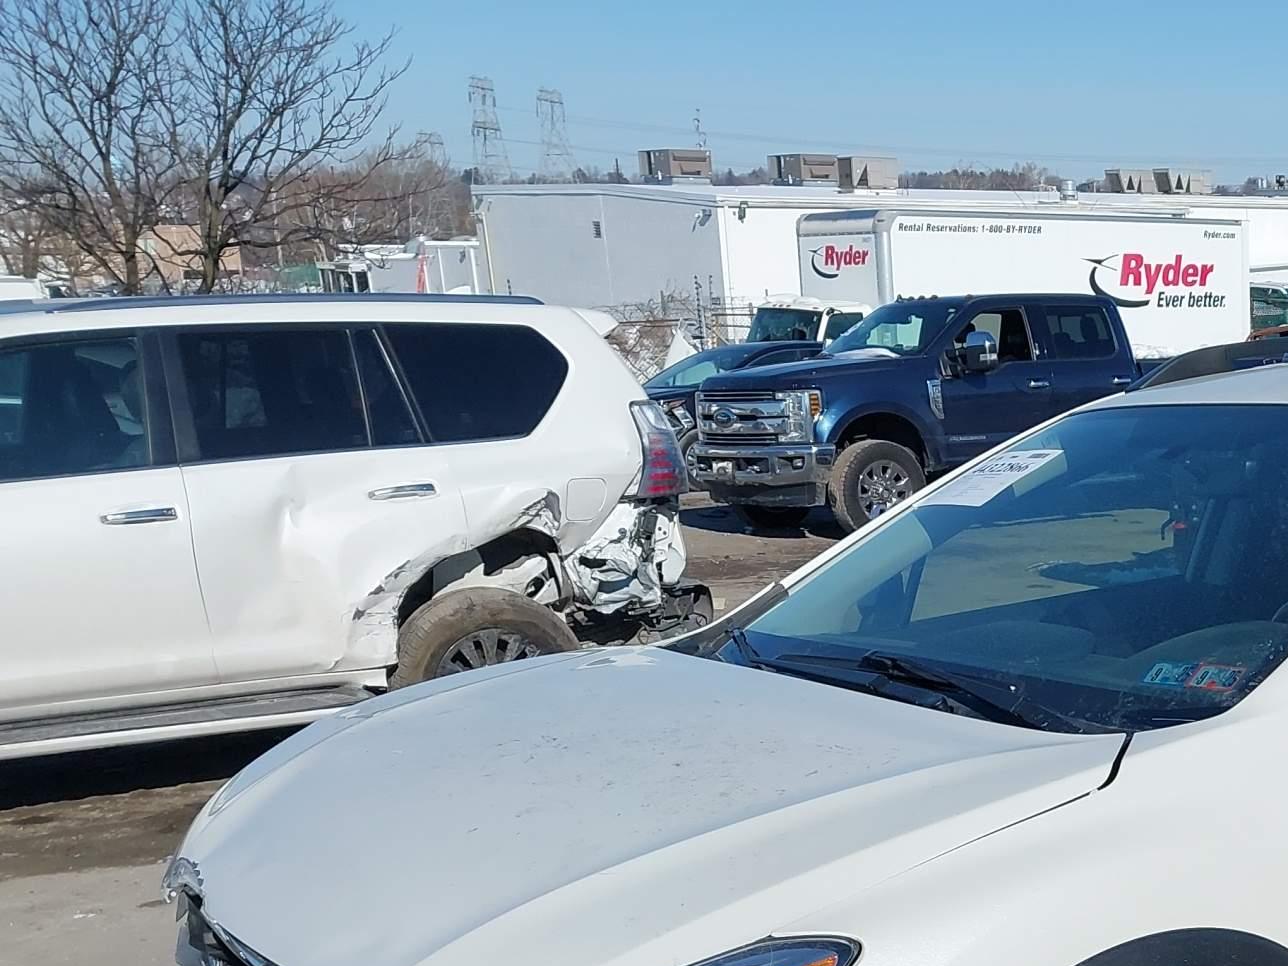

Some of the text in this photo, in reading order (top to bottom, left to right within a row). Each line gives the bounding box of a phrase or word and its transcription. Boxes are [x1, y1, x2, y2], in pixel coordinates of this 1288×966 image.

[898, 222, 1042, 234] Rental Reservations: 1-800-BY-RYDER
[1203, 230, 1236, 240] Ryder.com
[824, 244, 869, 271] Ryder
[1119, 253, 1215, 295] Ryder
[1156, 291, 1227, 308] Ever better.
